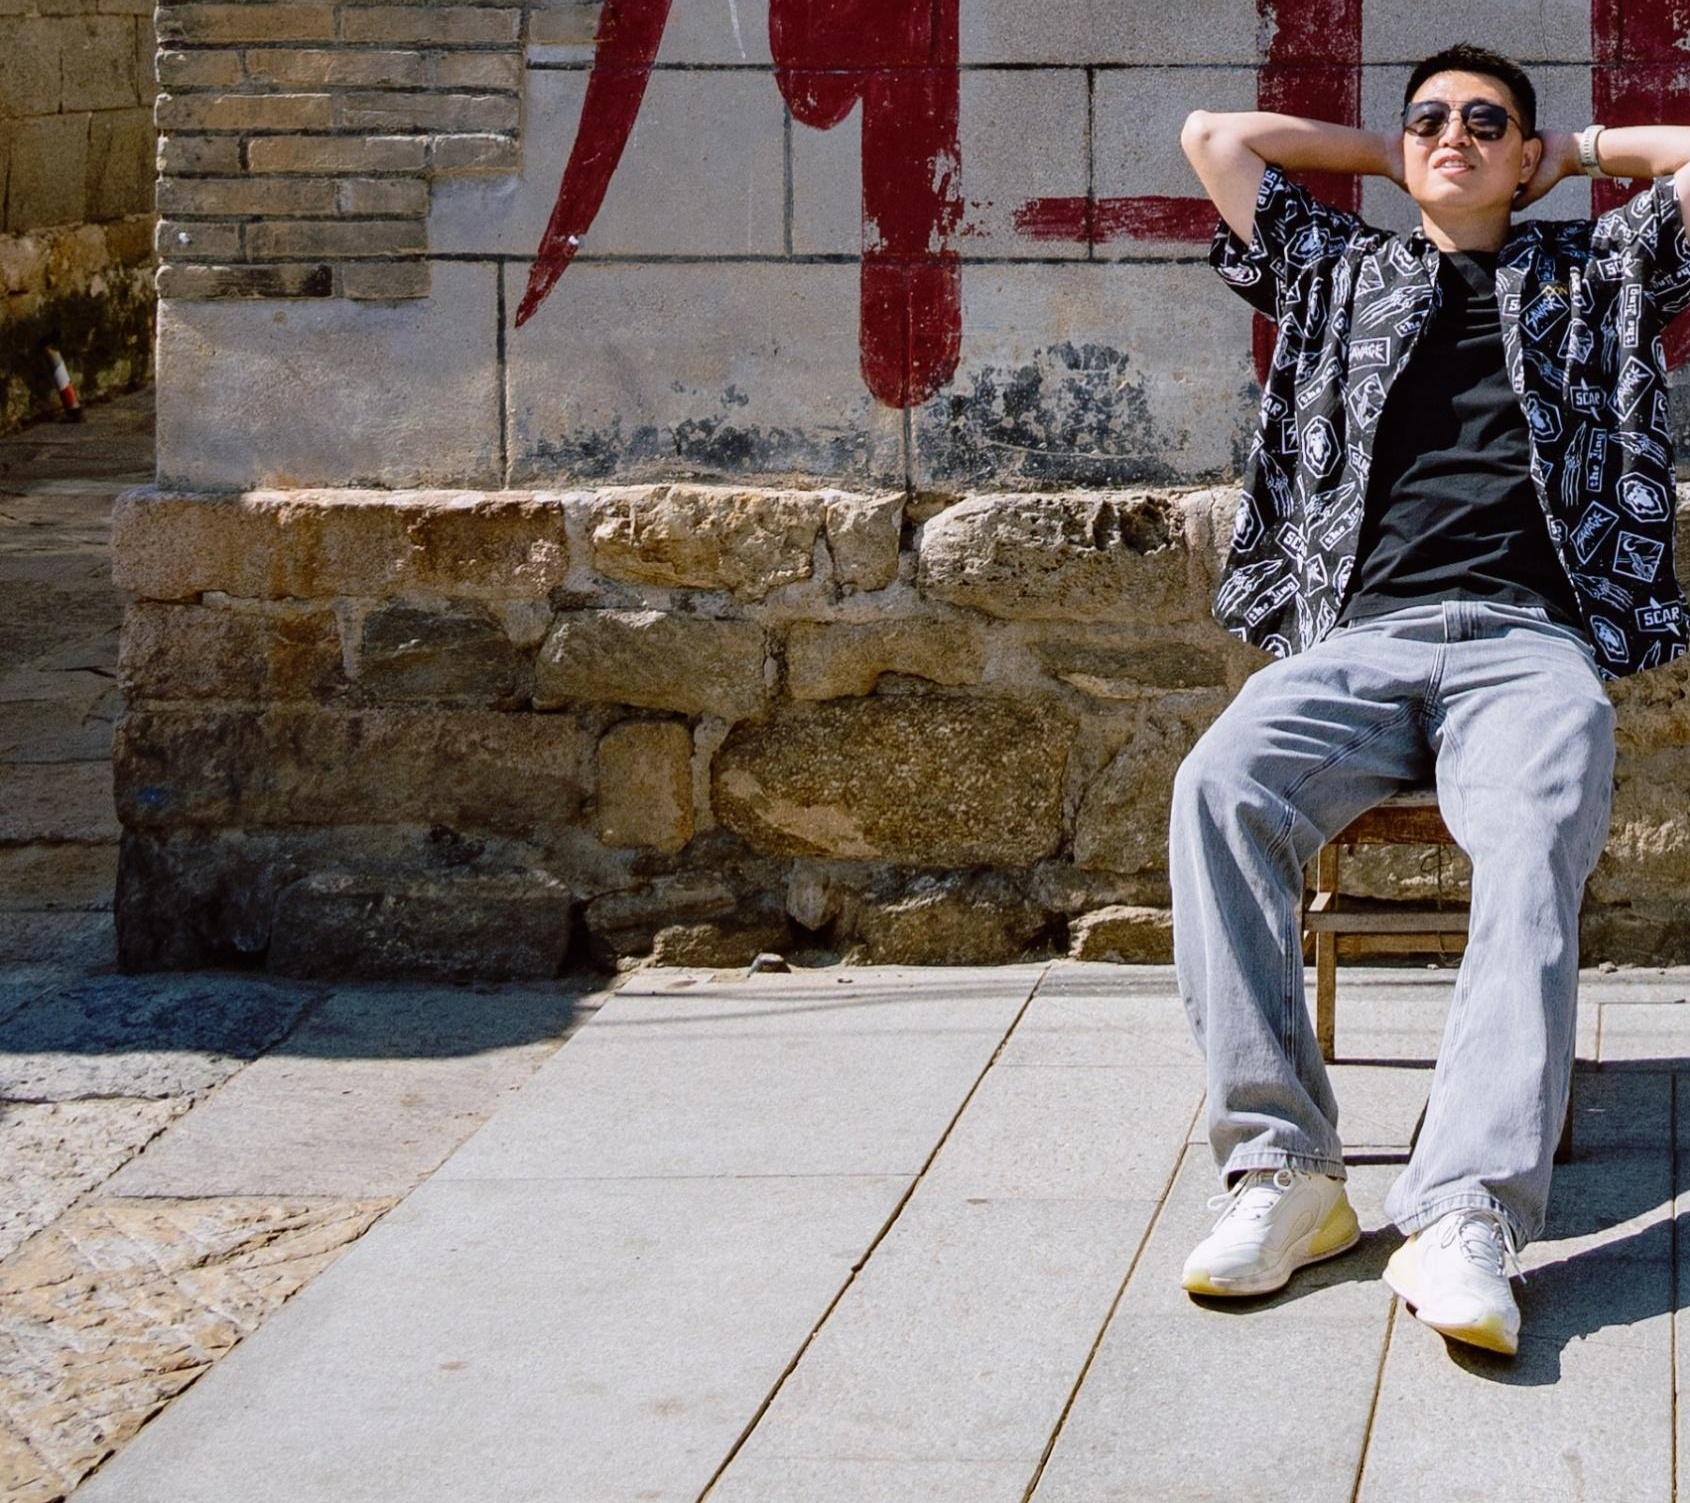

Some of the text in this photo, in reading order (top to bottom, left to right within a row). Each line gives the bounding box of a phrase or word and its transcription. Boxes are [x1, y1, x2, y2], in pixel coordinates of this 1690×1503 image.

[1349, 342, 1386, 363] AVAGE
[1575, 391, 1601, 406] SCAR
[1589, 465, 1600, 488] the
[1643, 606, 1681, 626] SCAR
